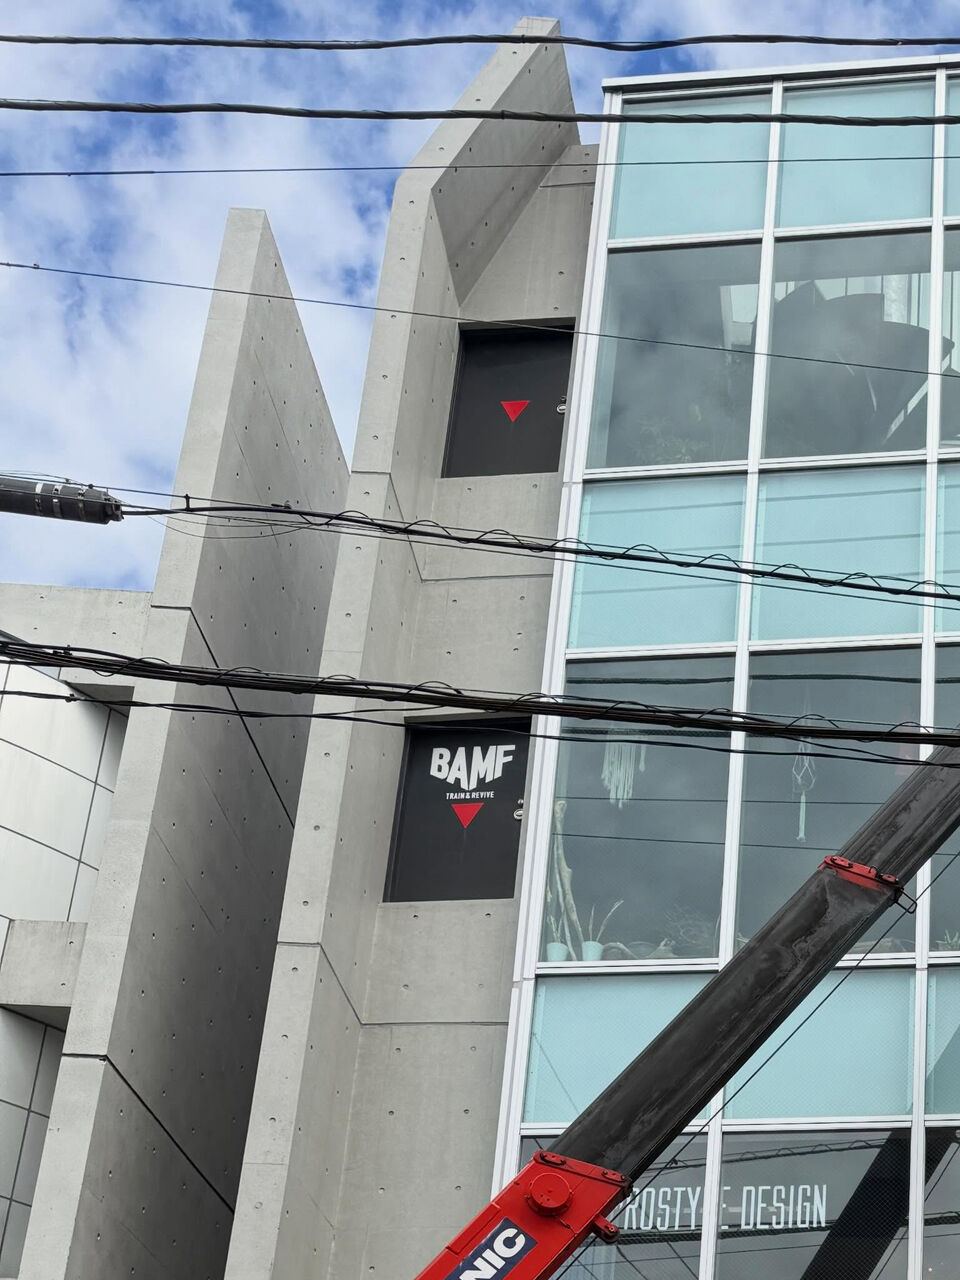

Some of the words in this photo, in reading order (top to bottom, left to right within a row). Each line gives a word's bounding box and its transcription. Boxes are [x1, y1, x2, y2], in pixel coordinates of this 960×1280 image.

[430, 745, 516, 791] BAMF
[446, 792, 465, 800] TRAIN
[465, 791, 471, 799] &
[471, 791, 495, 799] REVIVE
[620, 1185, 731, 1231] ROSTYE
[741, 1184, 827, 1230] DESIGN
